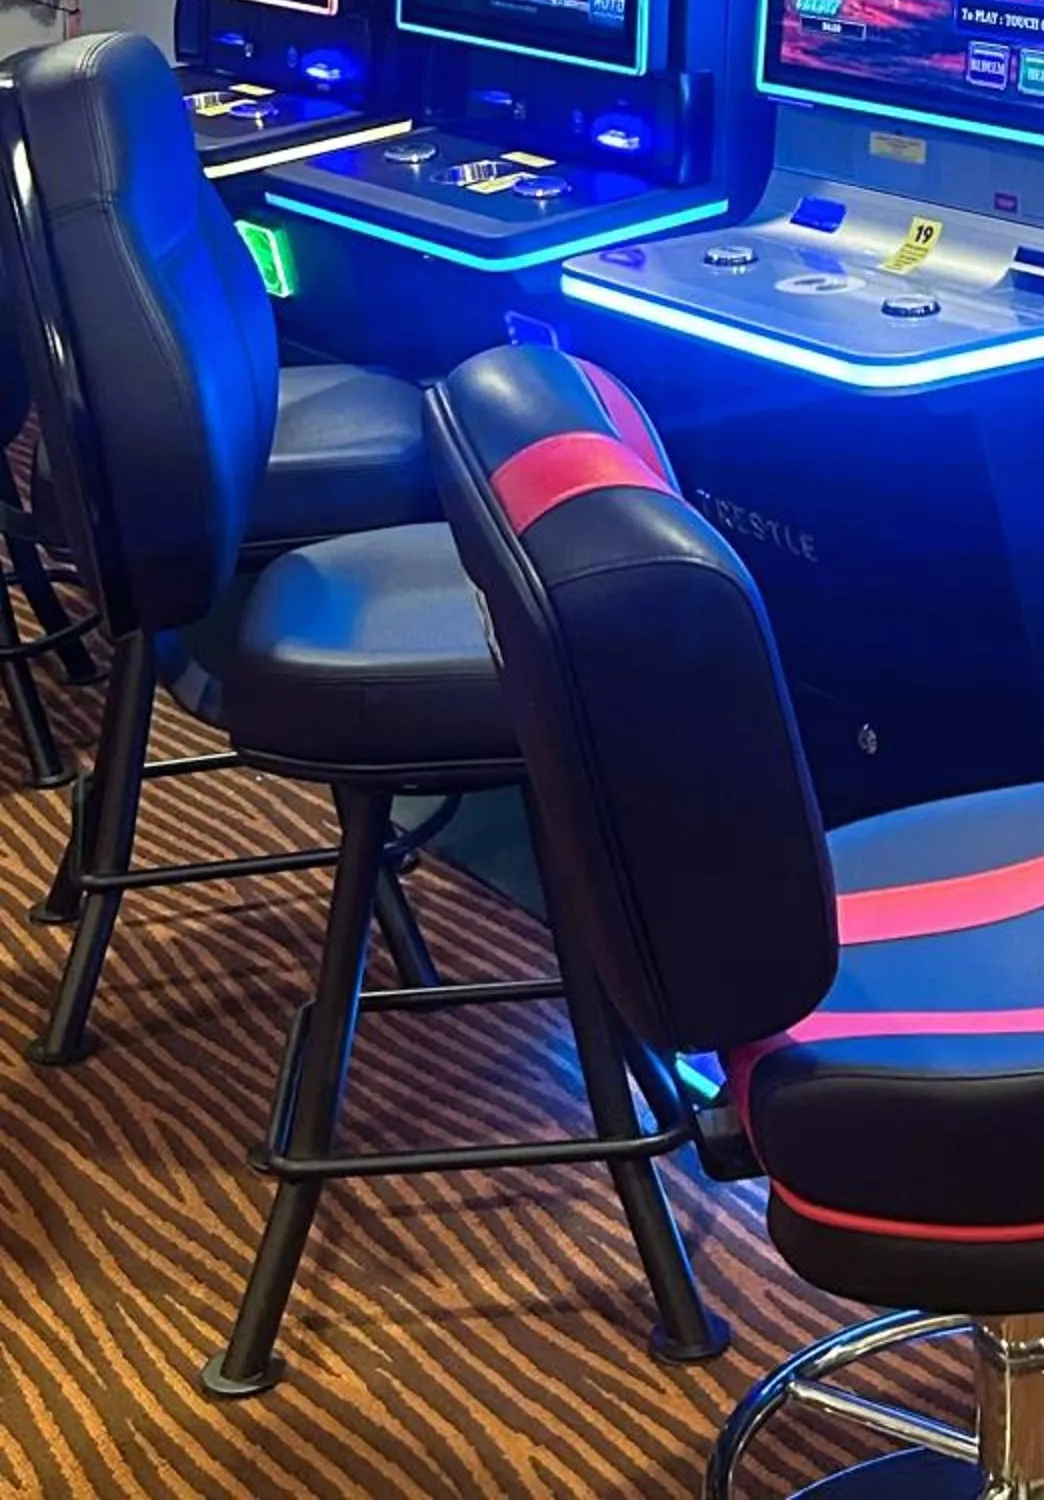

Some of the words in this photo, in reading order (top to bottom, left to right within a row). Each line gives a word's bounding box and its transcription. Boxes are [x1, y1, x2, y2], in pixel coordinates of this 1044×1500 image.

[961, 8, 974, 21] To
[975, 10, 998, 25] PLAY
[1005, 14, 1040, 31] TOUCH
[915, 224, 934, 245] 19
